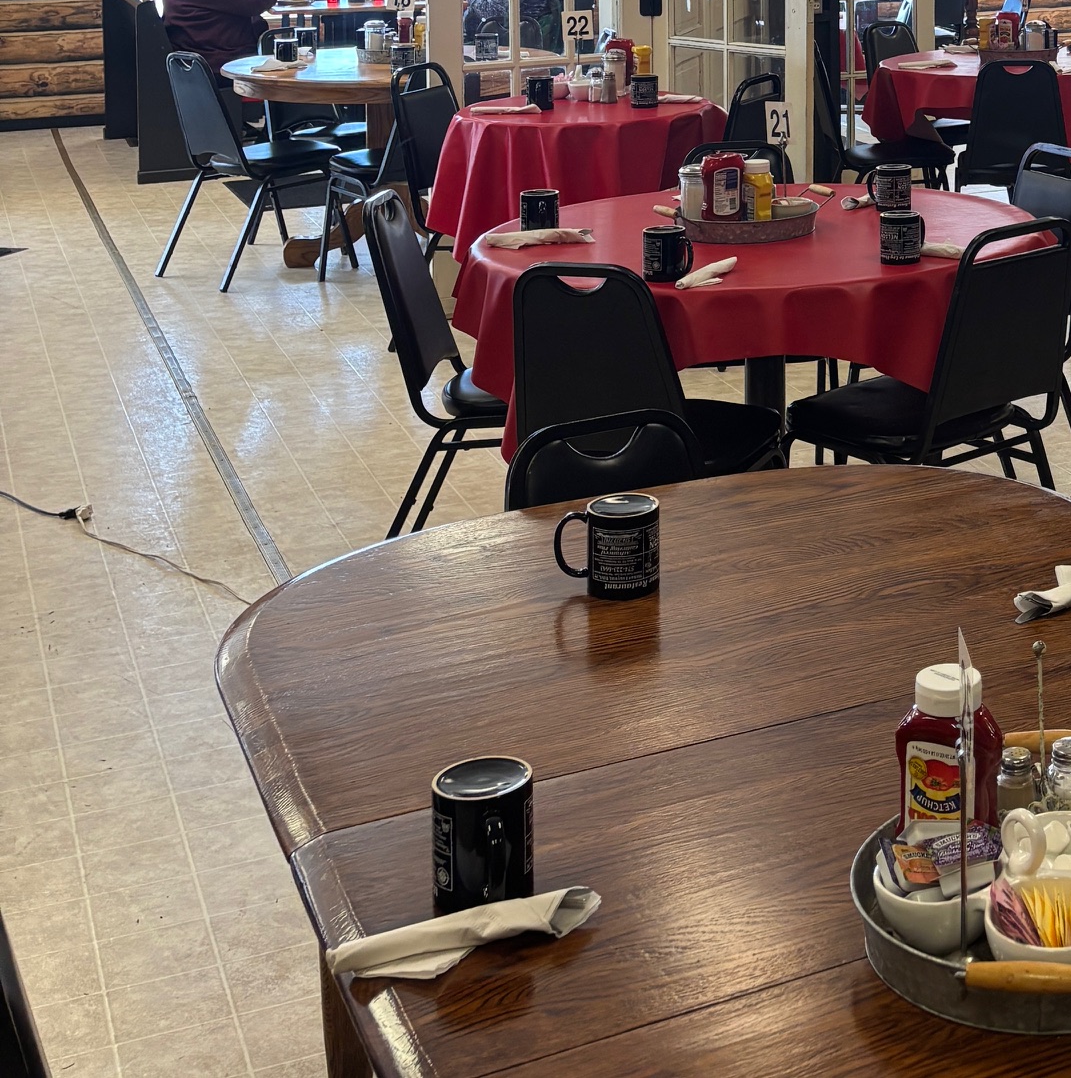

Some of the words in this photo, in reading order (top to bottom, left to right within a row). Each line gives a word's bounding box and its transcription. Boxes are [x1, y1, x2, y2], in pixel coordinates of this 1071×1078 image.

[566, 15, 590, 37] 22
[769, 109, 790, 138] 21
[604, 579, 648, 590] Restaurant
[916, 794, 957, 812] KETCHUP
